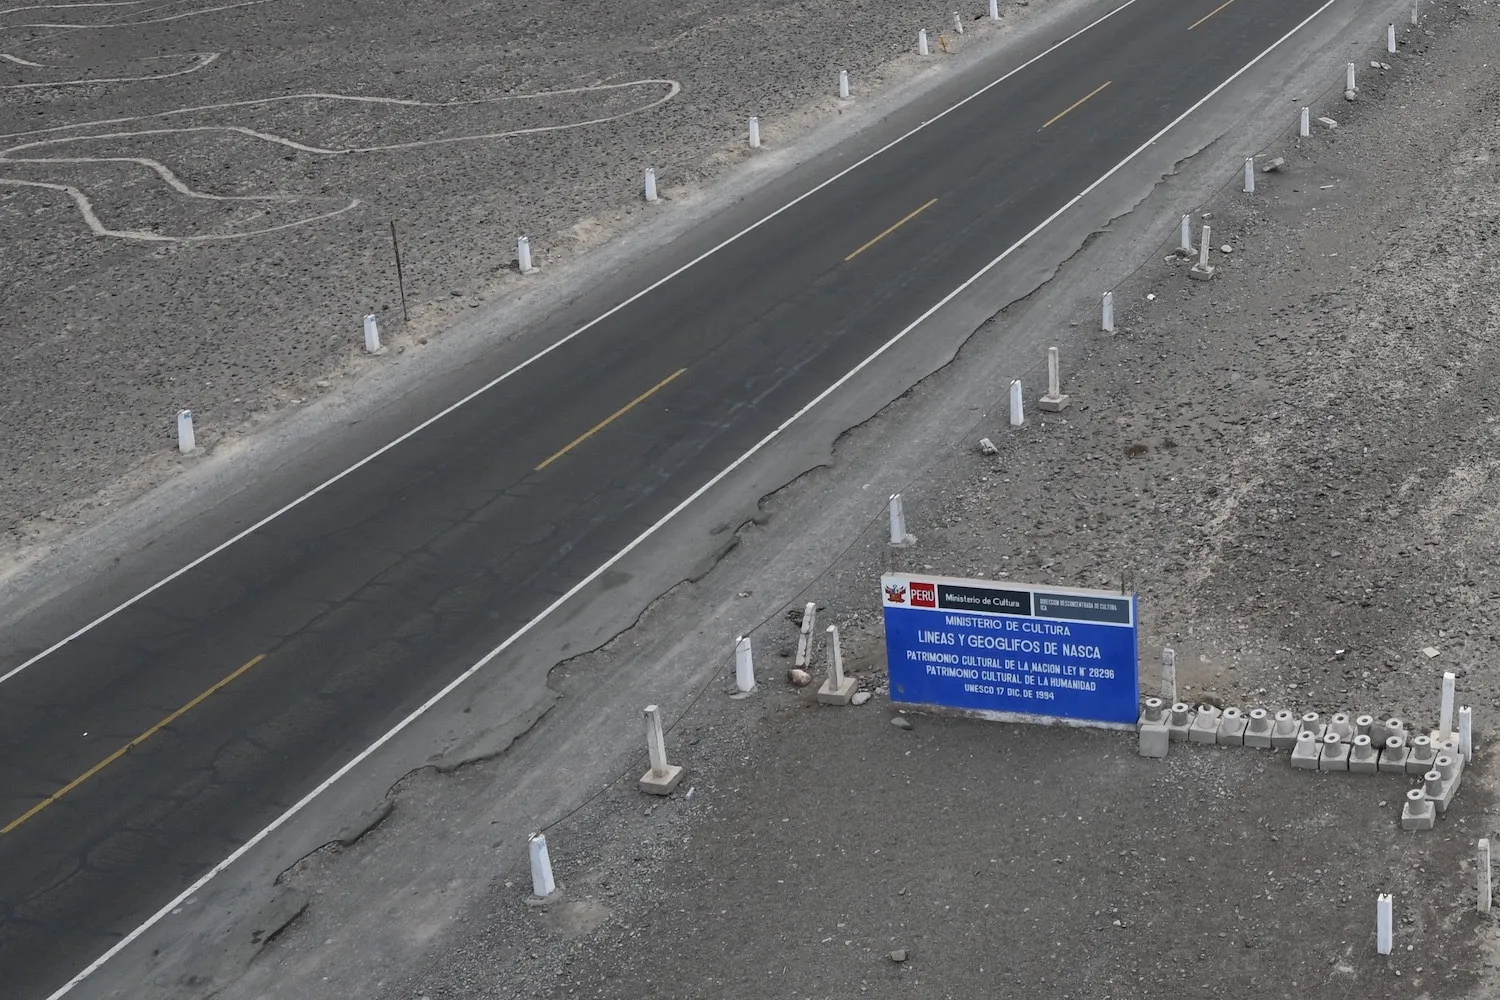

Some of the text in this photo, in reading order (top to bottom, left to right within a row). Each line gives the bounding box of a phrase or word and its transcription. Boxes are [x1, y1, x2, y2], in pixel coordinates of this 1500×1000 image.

[945, 593, 1020, 608] Ministerio de Cultura
[945, 615, 1071, 636] MINISTERIO DE CULTURA
[918, 630, 1101, 659] LINEAS Y GEOGLIFOS DE NASCA
[906, 650, 959, 664] PATRIMONIO
[962, 655, 1002, 669] CULTURAL
[1005, 660, 1015, 669] DE
[1018, 661, 1029, 671] LA
[1063, 666, 1077, 676] LEY
[1089, 668, 1115, 680] 28296
[926, 665, 1096, 692] PATRIMONIO CULTURAL DE LA HUMANIDAD
[964, 684, 994, 694] UNESCO
[996, 687, 1005, 696] 17
[1023, 689, 1033, 698] DE
[1036, 691, 1055, 700] 1994
